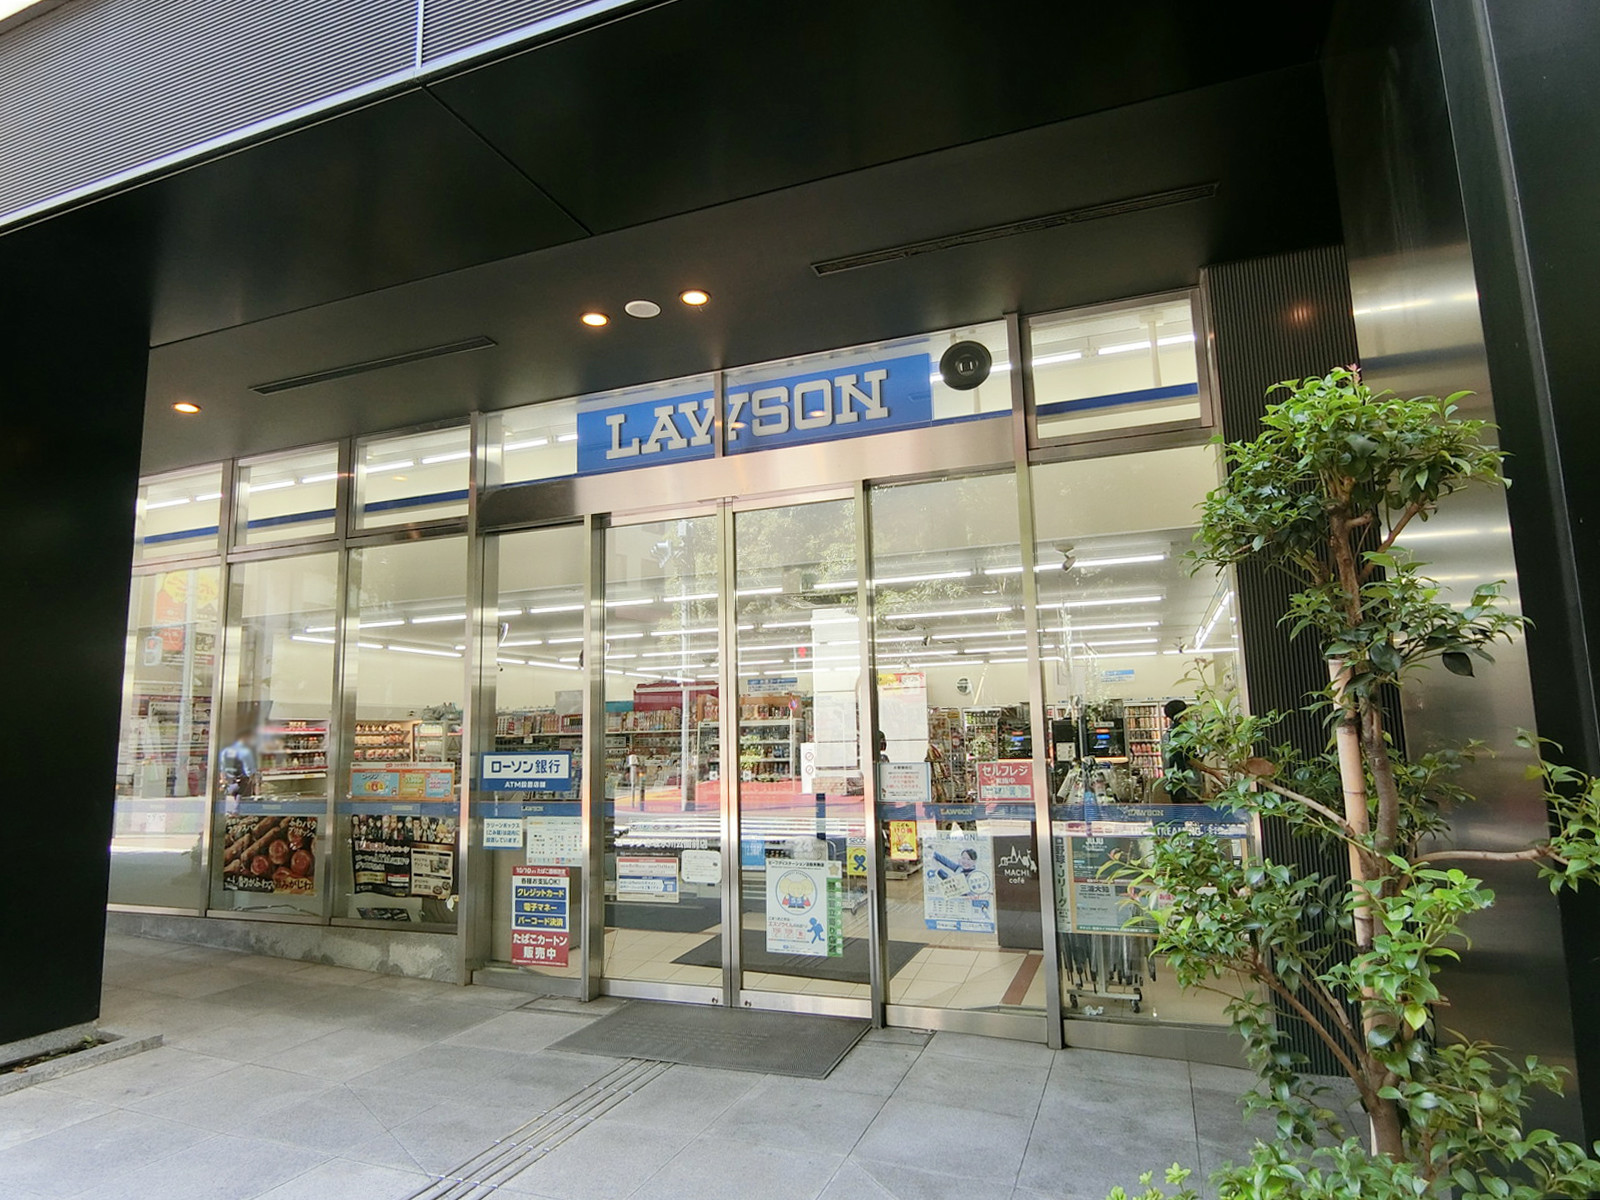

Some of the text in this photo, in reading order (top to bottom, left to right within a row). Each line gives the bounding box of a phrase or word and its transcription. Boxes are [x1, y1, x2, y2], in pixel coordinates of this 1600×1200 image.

[605, 368, 889, 461] LAWSON
[491, 759, 561, 774] ローソン銀行
[982, 764, 1029, 777] セルフレジ
[504, 781, 546, 789] ATM設置店舗
[940, 808, 973, 816] LAWSON
[1004, 869, 1030, 877] MACHI
[517, 888, 565, 898] クレジットカード
[523, 902, 558, 912] 電子マネー
[518, 916, 564, 927] バーコード決済
[512, 933, 568, 947] たばこカートン
[523, 946, 557, 960] 販売中
